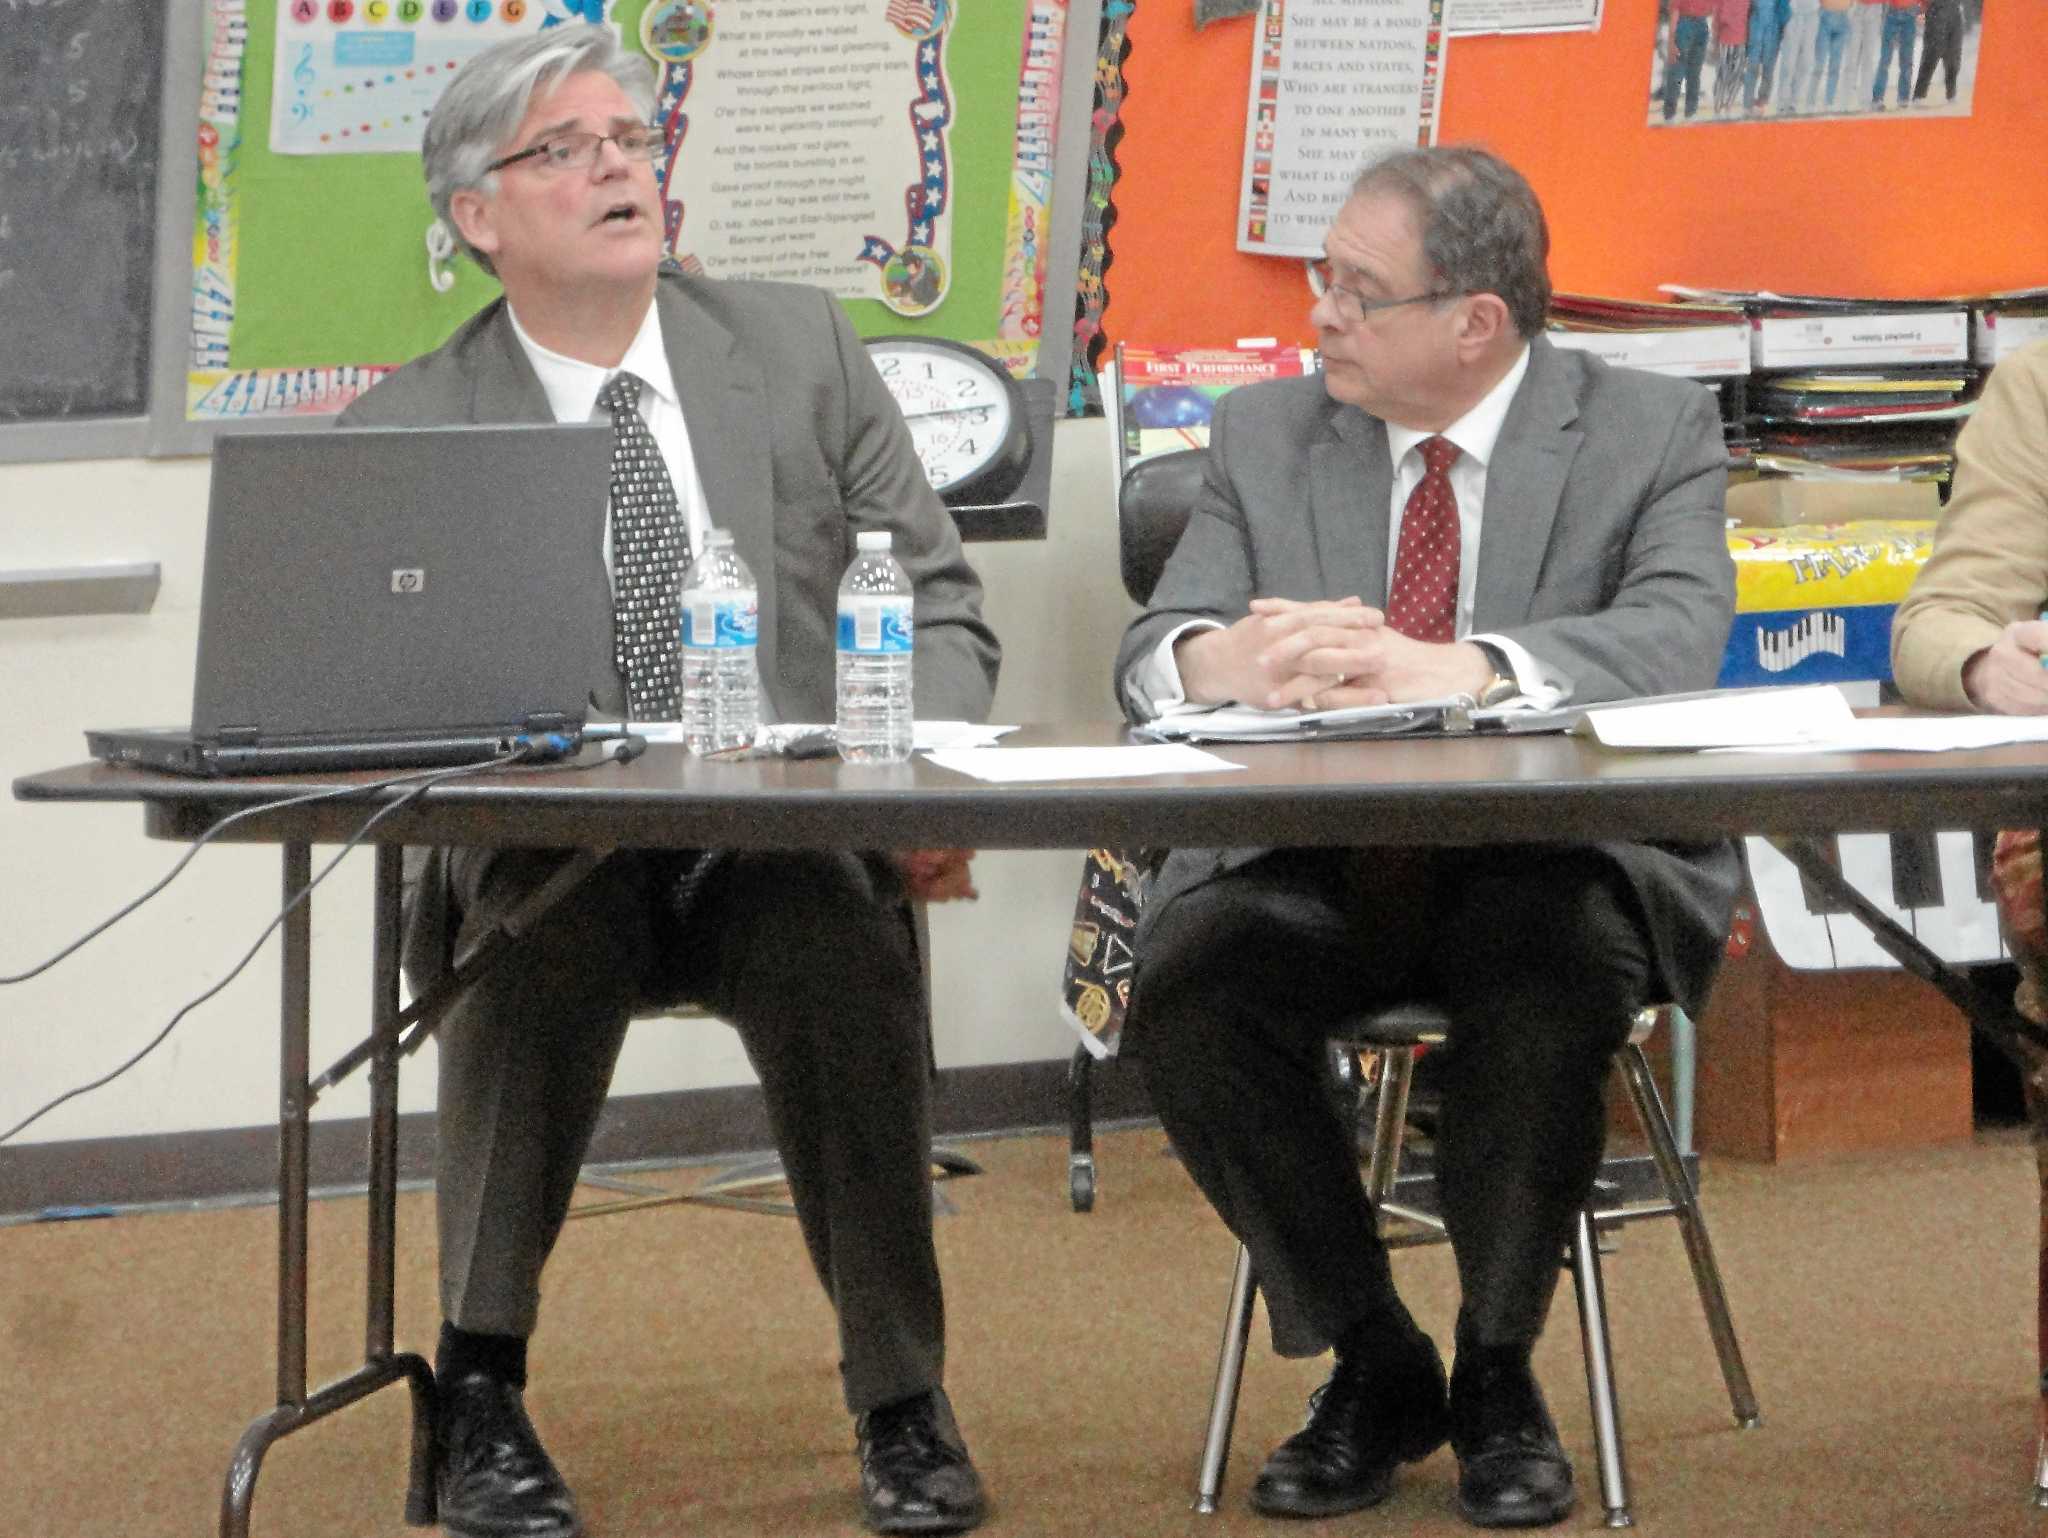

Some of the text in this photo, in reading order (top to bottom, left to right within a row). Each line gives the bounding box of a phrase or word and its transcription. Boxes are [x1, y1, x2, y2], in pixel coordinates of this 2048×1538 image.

[298, 0, 311, 16] A
[368, 0, 387, 17] C
[402, 0, 419, 16] D
[506, 0, 521, 16] G
[756, 8, 773, 18] the
[1322, 17, 1348, 27] MAY
[1354, 17, 1368, 27] BE
[1294, 39, 1417, 50] BETWEEN NATIONS,
[752, 47, 769, 57] the
[829, 63, 848, 74] and
[1293, 61, 1414, 73] RACES AND STATES,
[783, 83, 799, 94] the
[1283, 80, 1319, 93] WHO
[1323, 84, 1346, 94] ARE
[740, 106, 757, 116] the
[809, 104, 825, 113] we
[1294, 104, 1407, 116] TO ONE ANOTHER
[1300, 128, 1315, 138] IN
[1320, 127, 1358, 138] MANY
[714, 144, 736, 155] And
[738, 143, 756, 154] the
[803, 140, 821, 151] red
[1297, 149, 1323, 161] SHE
[1328, 150, 1356, 161] MAY
[734, 159, 751, 171] the
[1279, 169, 1318, 181] WHAT
[1324, 169, 1335, 180] IS
[742, 177, 771, 192] proof
[774, 176, 815, 189] through
[818, 175, 835, 185] the
[838, 173, 865, 186] night
[731, 197, 752, 208] that
[798, 192, 819, 202] was
[1286, 190, 1317, 202] AND
[750, 216, 774, 228] does
[777, 214, 798, 225] that
[1273, 213, 1290, 224] TO
[728, 232, 767, 246] Banner
[769, 230, 787, 244] yet
[730, 254, 748, 265] the
[751, 252, 774, 263] land
[789, 249, 808, 260] the
[810, 248, 830, 260] free
[749, 269, 767, 279] the
[769, 266, 799, 278] home
[814, 263, 832, 274] the
[922, 361, 934, 379] 1
[1146, 360, 1277, 374] FIRST PERFORMANCE
[957, 379, 978, 397] 2
[956, 437, 977, 455] 4
[929, 464, 949, 485] 5
